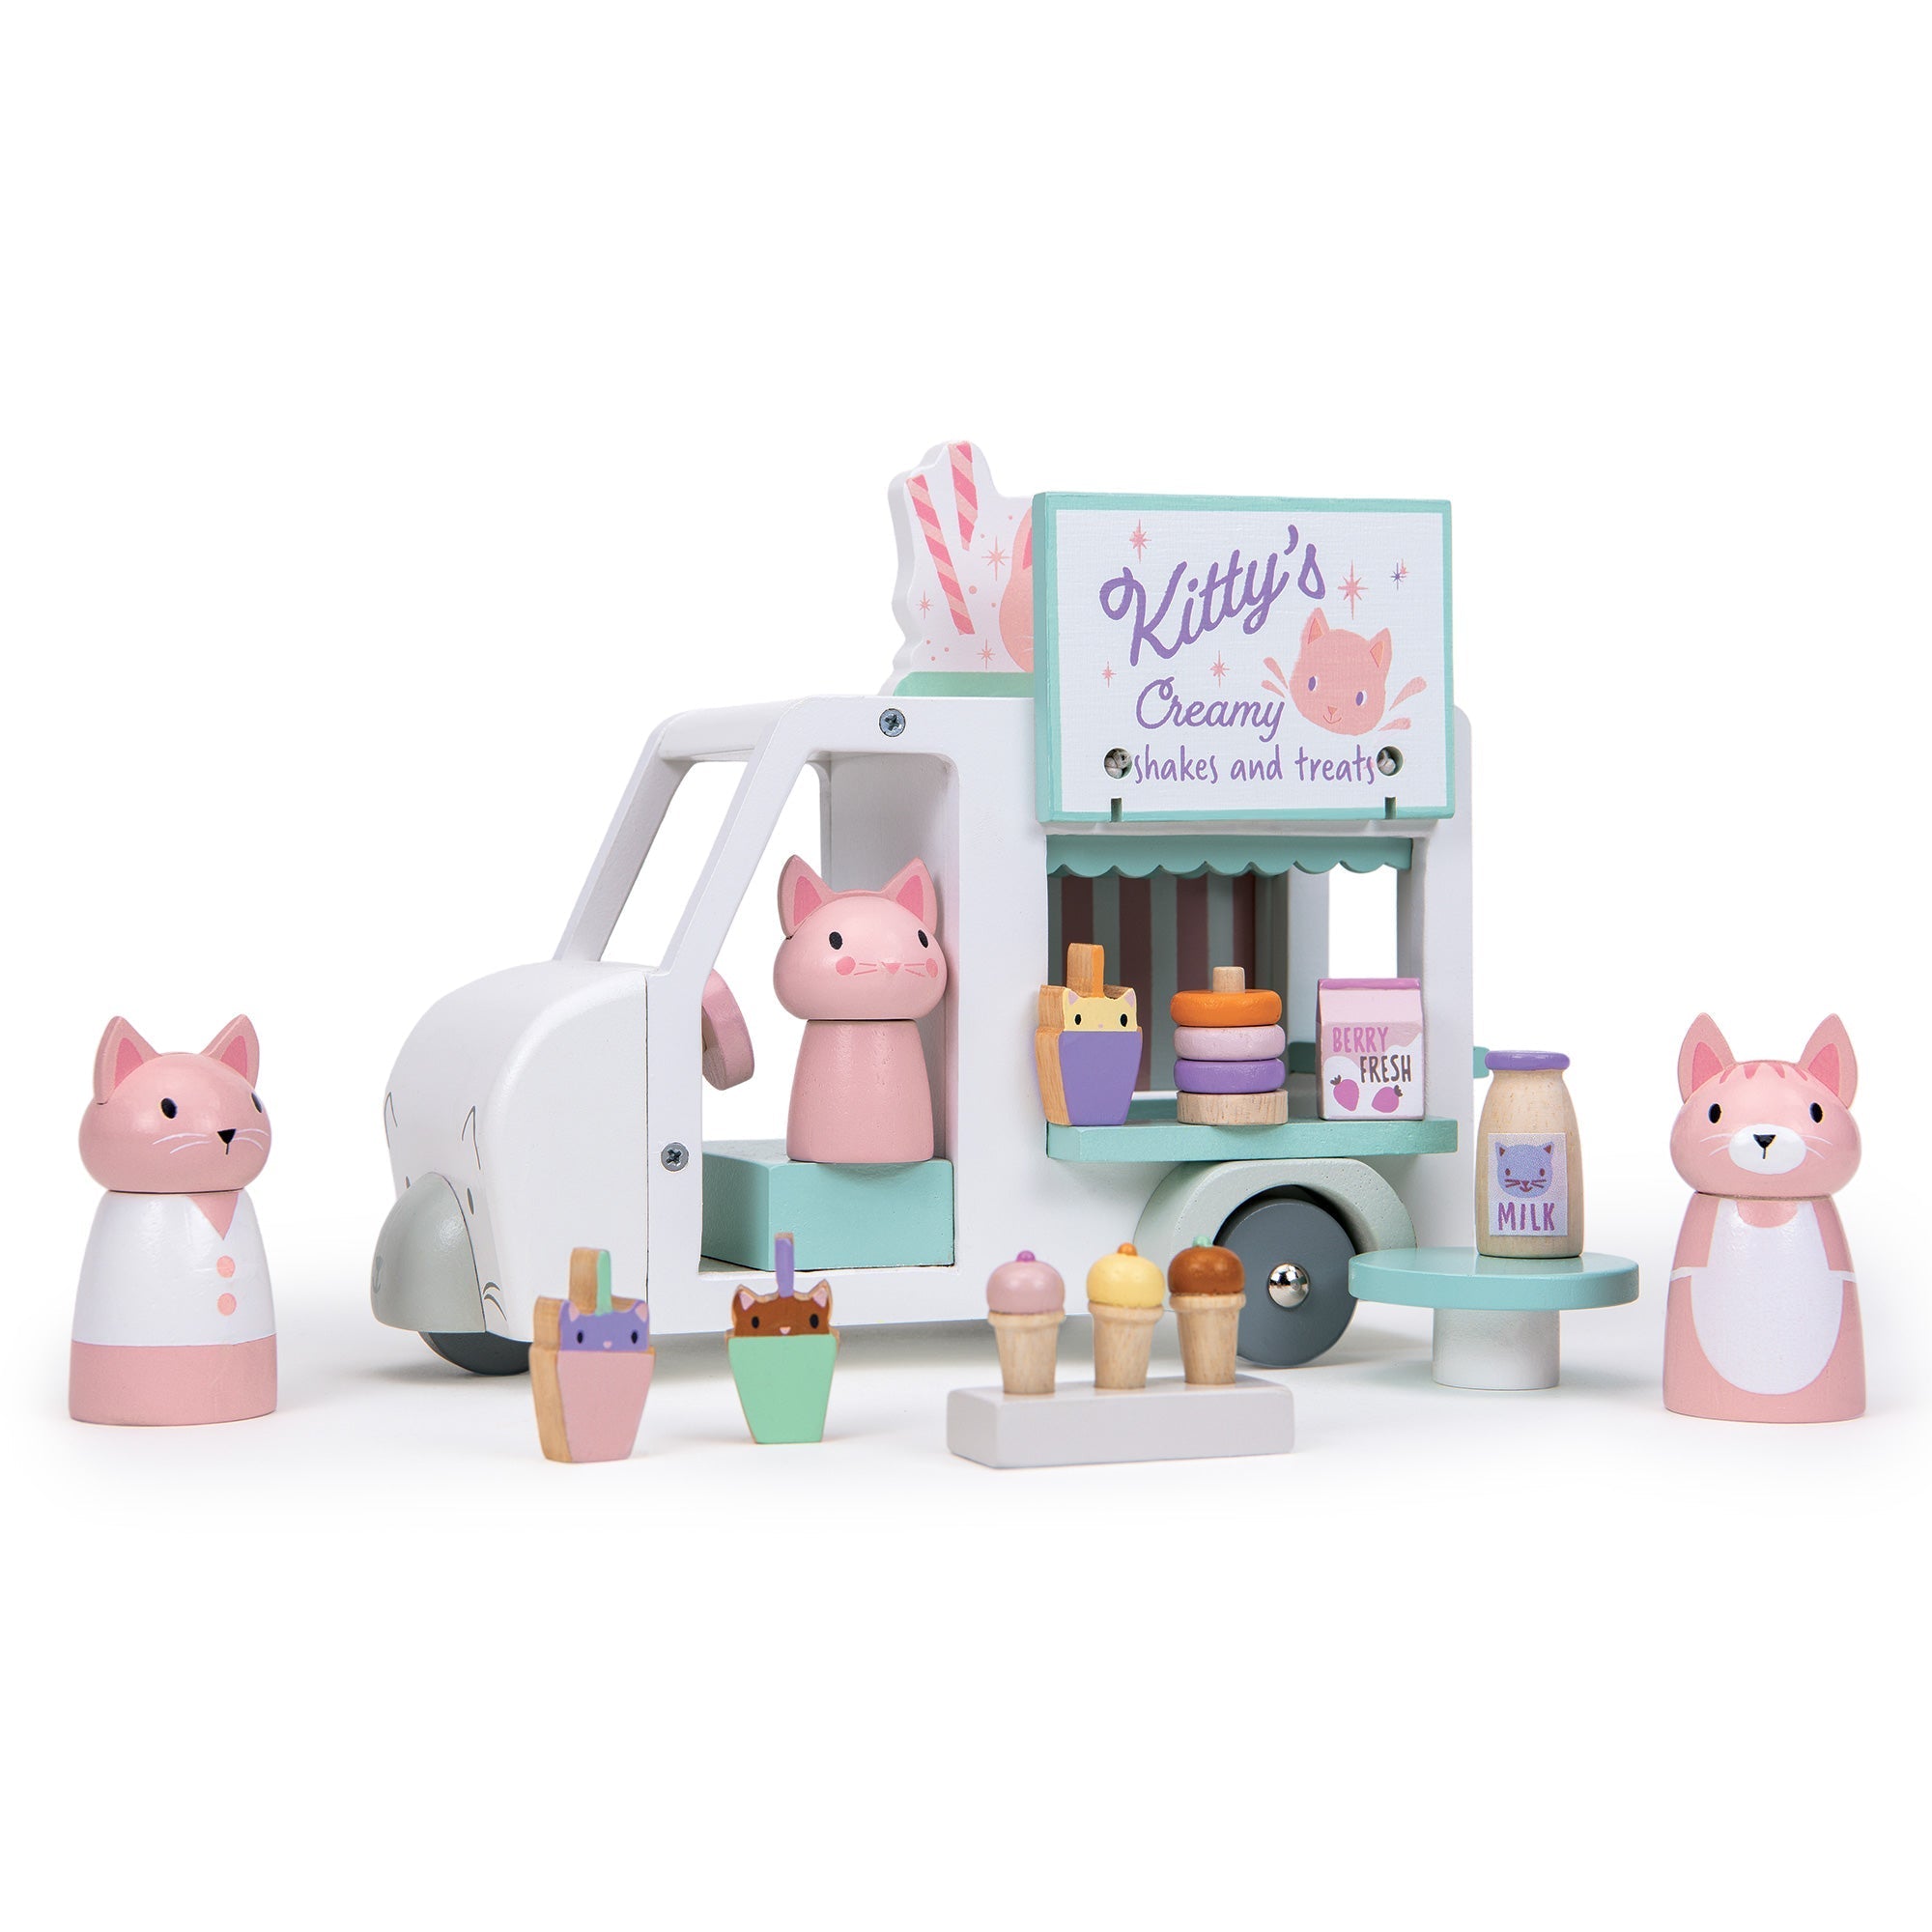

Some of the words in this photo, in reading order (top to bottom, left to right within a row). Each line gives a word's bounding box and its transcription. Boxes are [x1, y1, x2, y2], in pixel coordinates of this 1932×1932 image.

[1099, 525, 1326, 667] Kitty's
[1135, 676, 1285, 743] Creamy
[1134, 744, 1218, 784] shakes
[1230, 744, 1284, 781] and
[1293, 744, 1376, 784] treats
[1332, 1026, 1389, 1054] BERRY
[1359, 1054, 1412, 1083] FRESH
[1497, 1202, 1555, 1232] MILK
